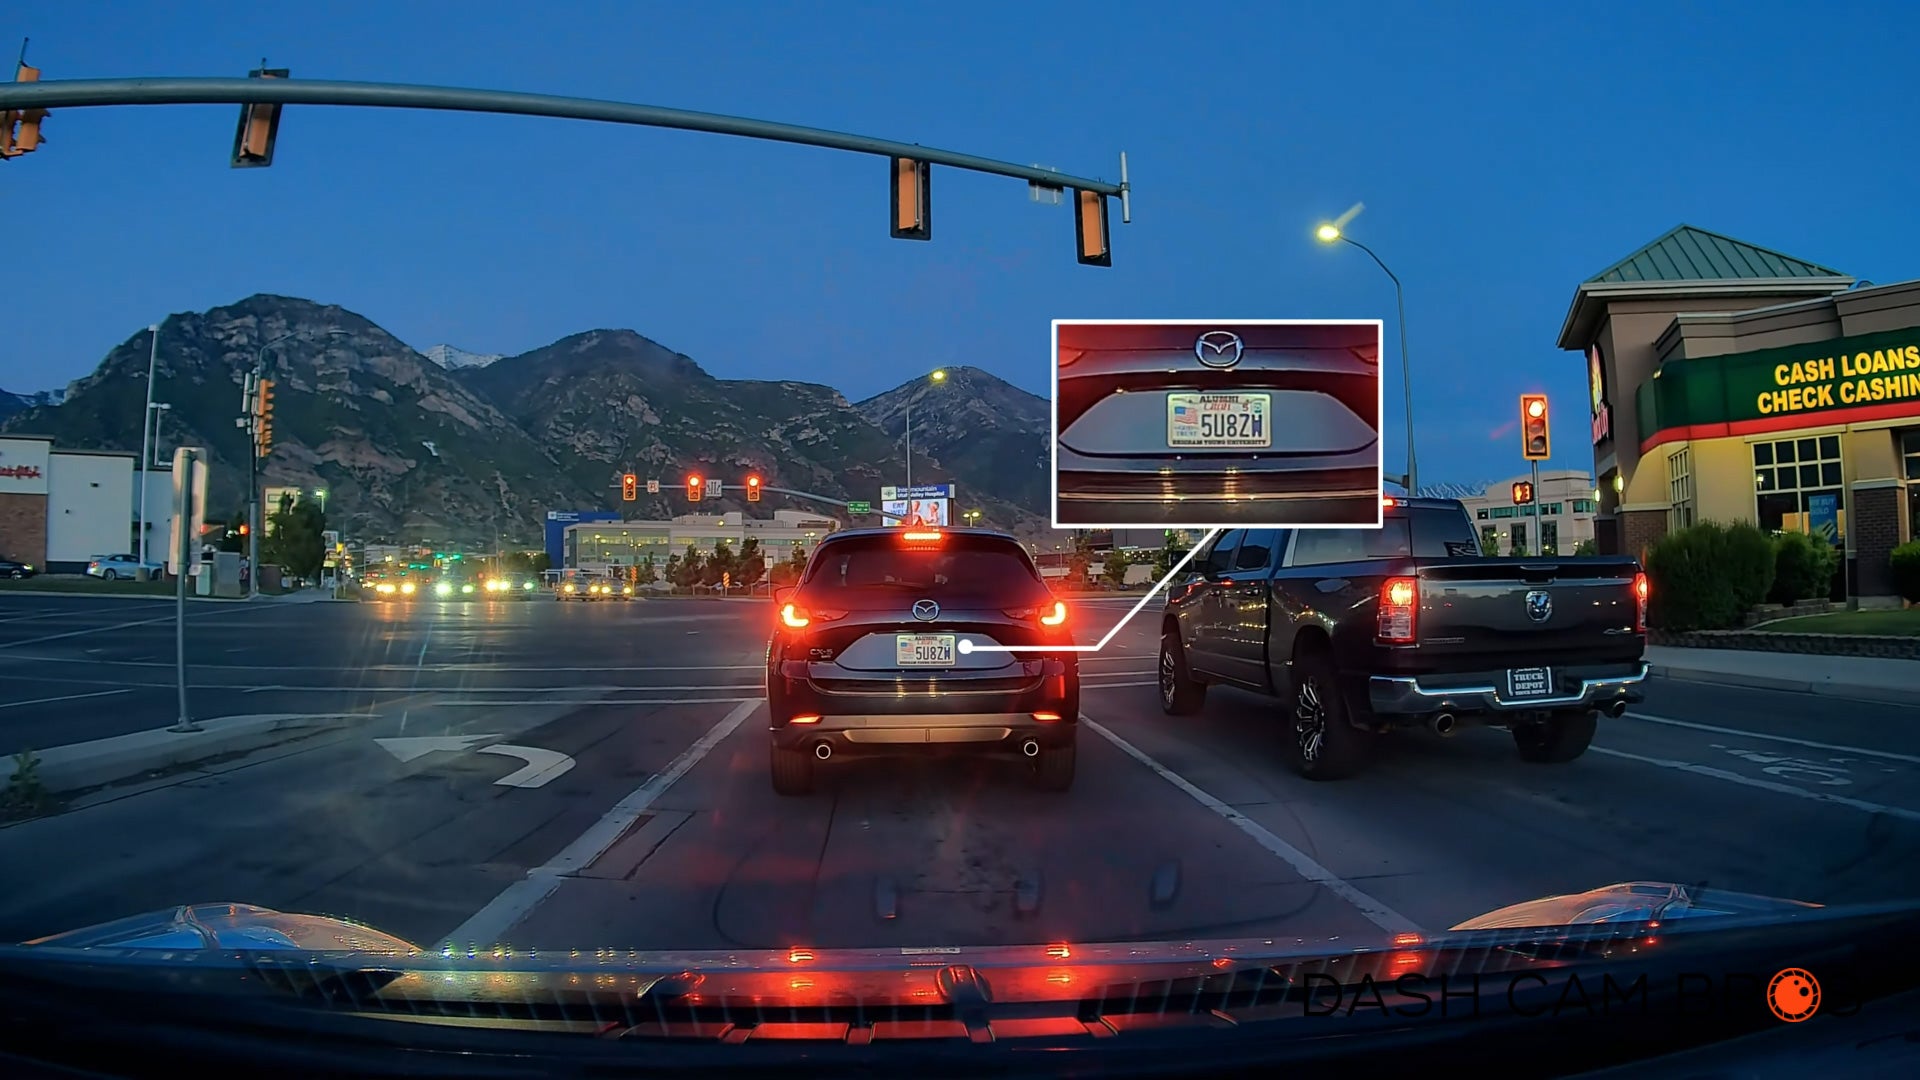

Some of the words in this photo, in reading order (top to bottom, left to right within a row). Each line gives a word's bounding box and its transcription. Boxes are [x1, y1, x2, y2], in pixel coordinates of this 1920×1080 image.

[1774, 357, 1835, 386] CASH
[1841, 345, 1920, 377] LOANS
[1757, 384, 1834, 414] CHECK
[1514, 673, 1544, 681] TRUCK
[1515, 681, 1544, 690] DEPOT
